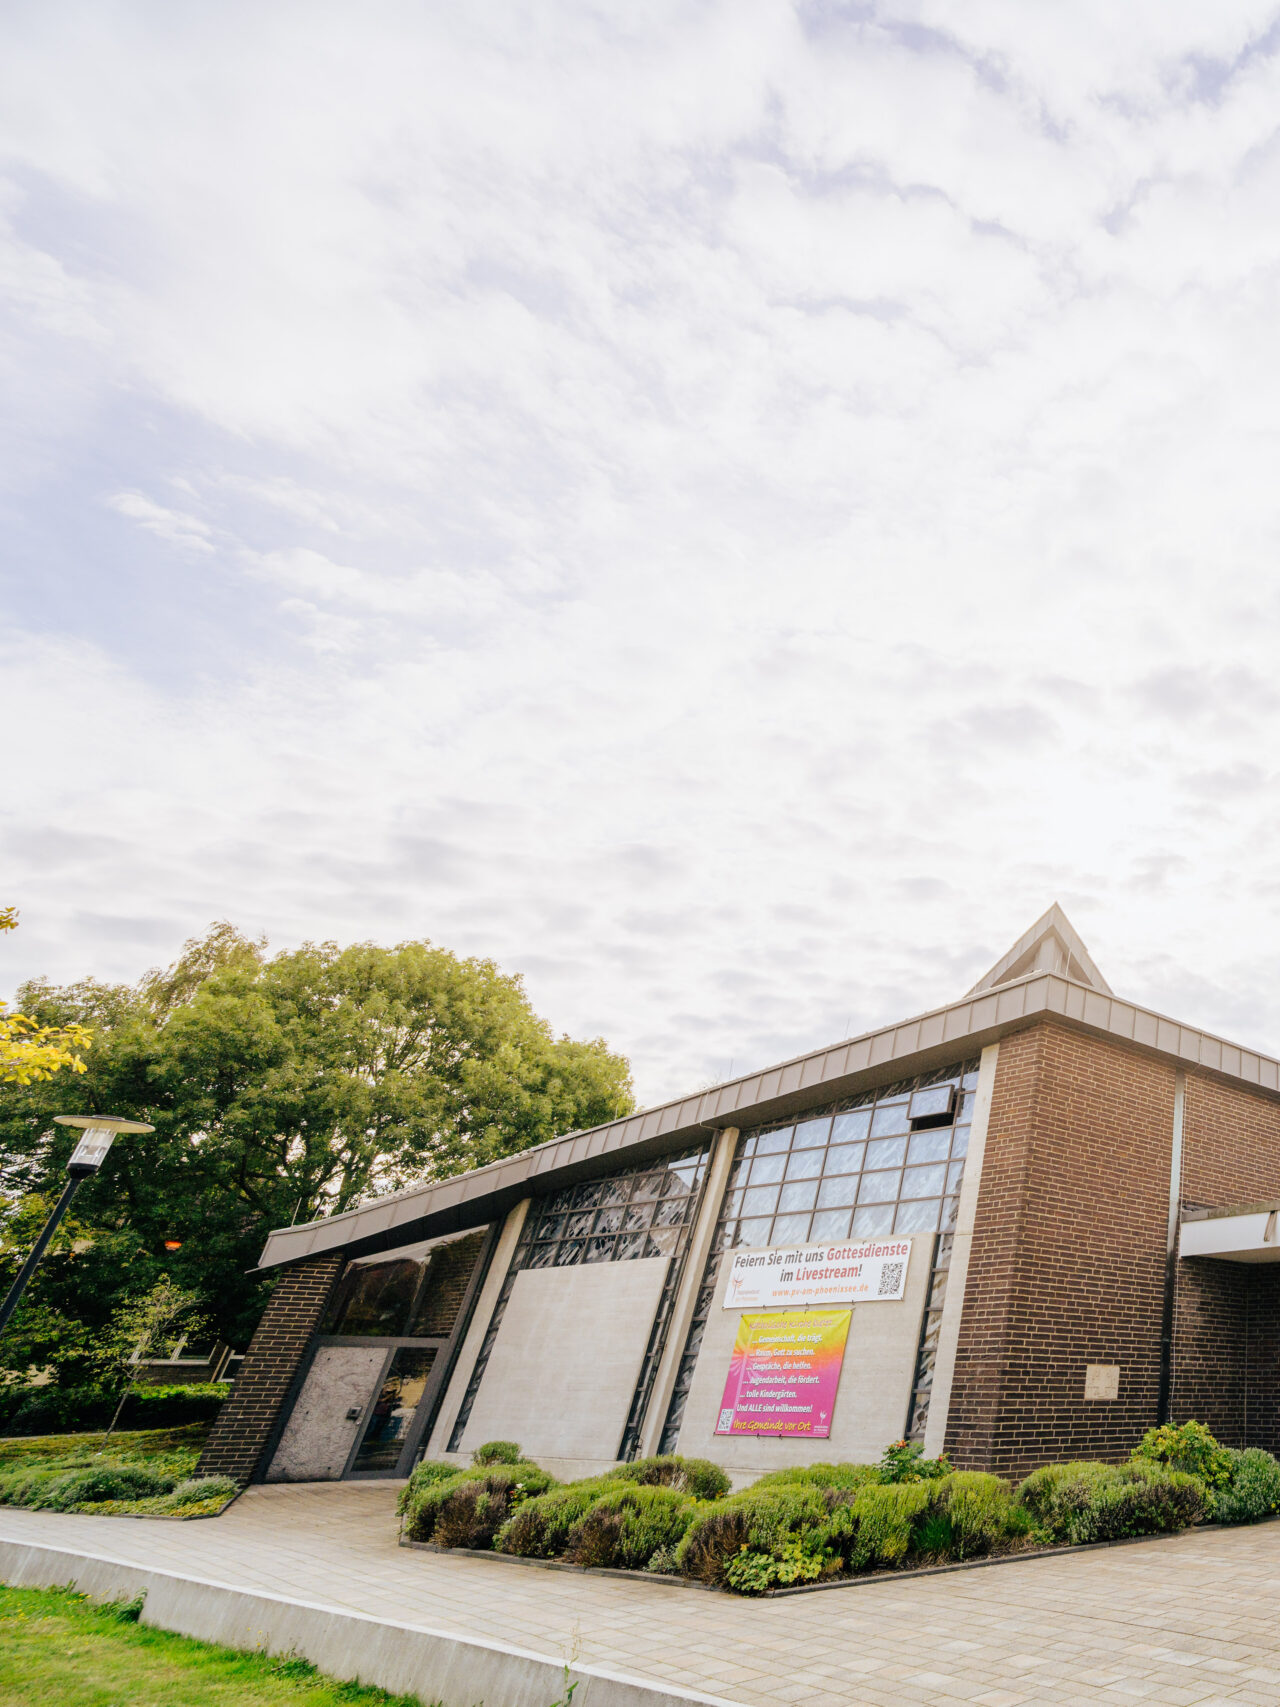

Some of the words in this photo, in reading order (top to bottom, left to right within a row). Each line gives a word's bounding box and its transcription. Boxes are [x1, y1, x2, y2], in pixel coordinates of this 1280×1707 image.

[735, 1254, 765, 1268] Feiern
[767, 1252, 783, 1265] Sie
[785, 1250, 803, 1264] mit
[805, 1251, 824, 1262] uns
[827, 1243, 908, 1261] Gottesdienste
[780, 1269, 793, 1282] im
[796, 1264, 863, 1281] Livestream!
[772, 1284, 868, 1297] www.pv-am-phoenixsee.de
[797, 1333, 806, 1342] die
[782, 1361, 792, 1370] die
[787, 1375, 797, 1384] die
[798, 1375, 819, 1384] fördert.
[746, 1389, 759, 1398] tolle
[760, 1390, 796, 1400] Kindergärten.
[737, 1404, 748, 1412] Und
[748, 1404, 763, 1412] ALLE
[763, 1404, 775, 1413] sind
[776, 1404, 812, 1413] willkommen!
[733, 1419, 747, 1429] Ihre
[747, 1418, 783, 1432] Gemeinde
[784, 1422, 797, 1431] vor
[798, 1421, 811, 1431] Ort
